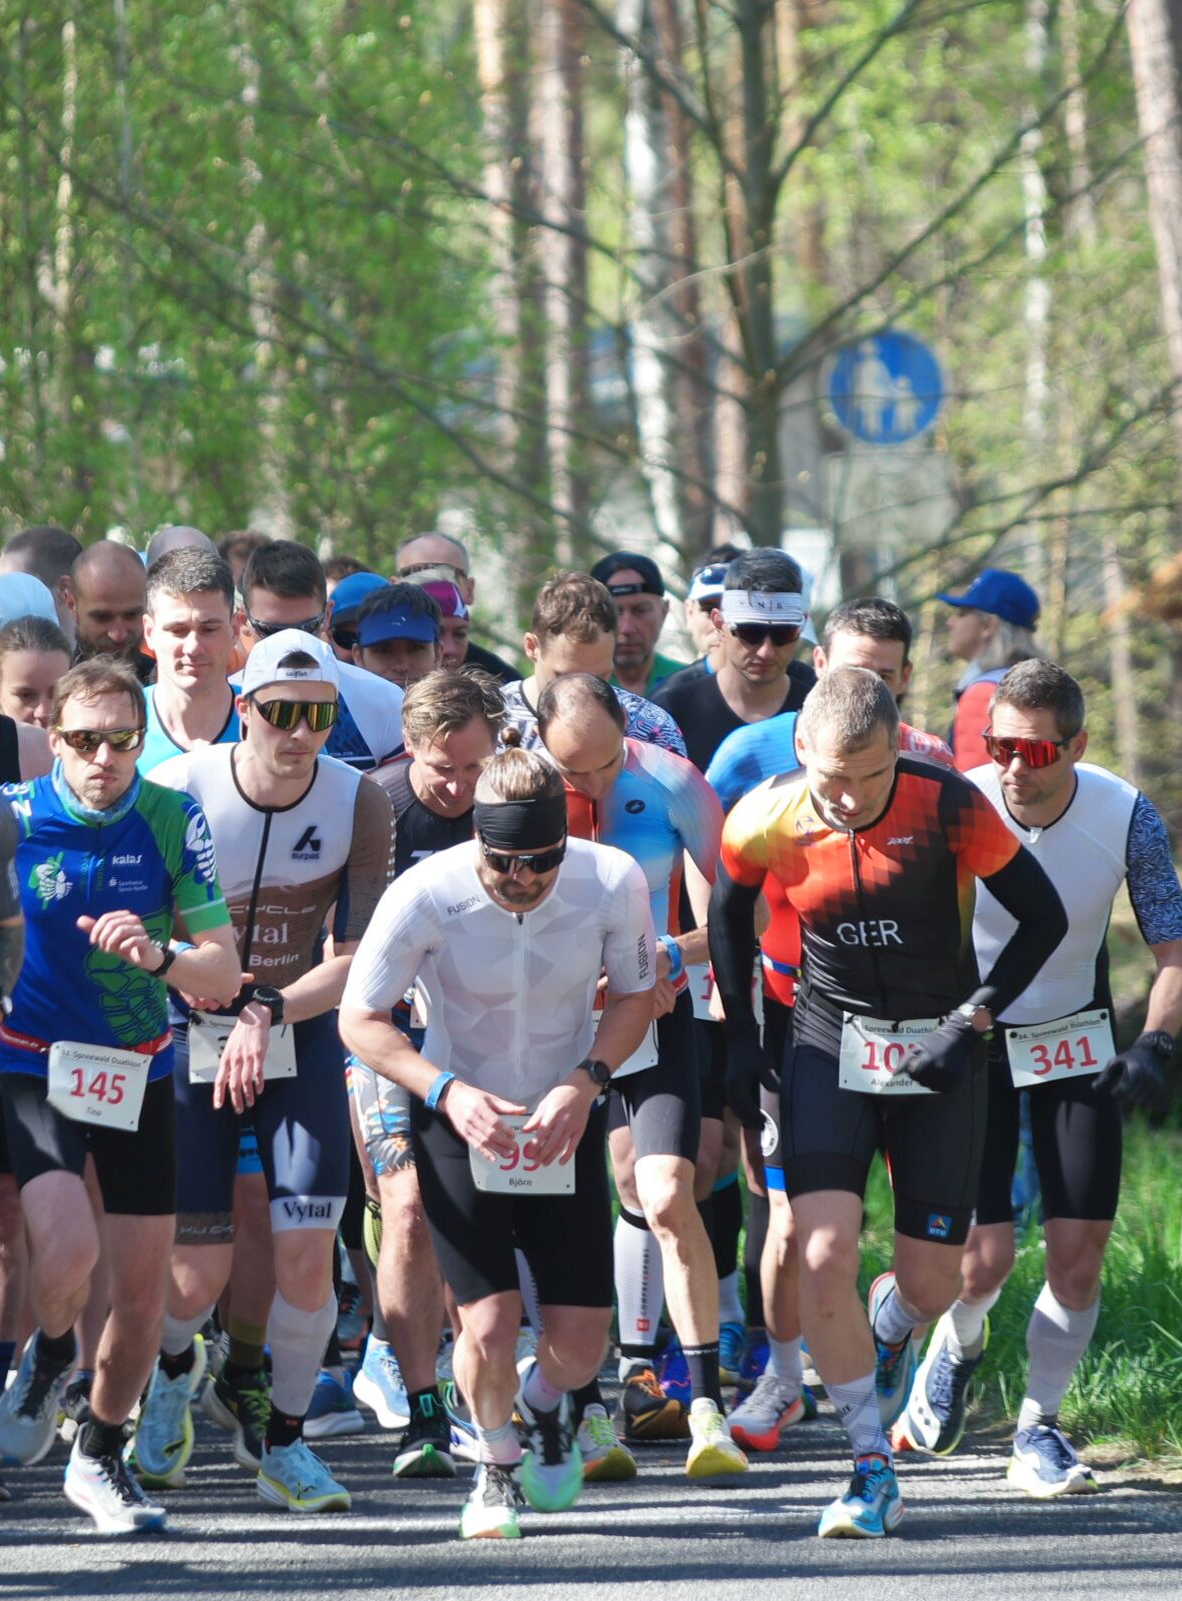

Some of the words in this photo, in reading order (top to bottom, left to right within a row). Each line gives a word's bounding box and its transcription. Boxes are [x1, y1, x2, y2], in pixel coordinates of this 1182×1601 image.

[112, 854, 142, 865] kalas
[448, 895, 481, 915] FUSION
[837, 920, 903, 946] GER
[249, 953, 299, 967] Berlin
[637, 933, 650, 980] FUSION
[861, 1041, 916, 1073] 10
[1029, 1036, 1098, 1076] 341
[70, 1067, 126, 1105] 145
[871, 1078, 914, 1087] Alexander
[509, 1177, 533, 1187] Björn
[283, 1201, 332, 1222] Vytal
